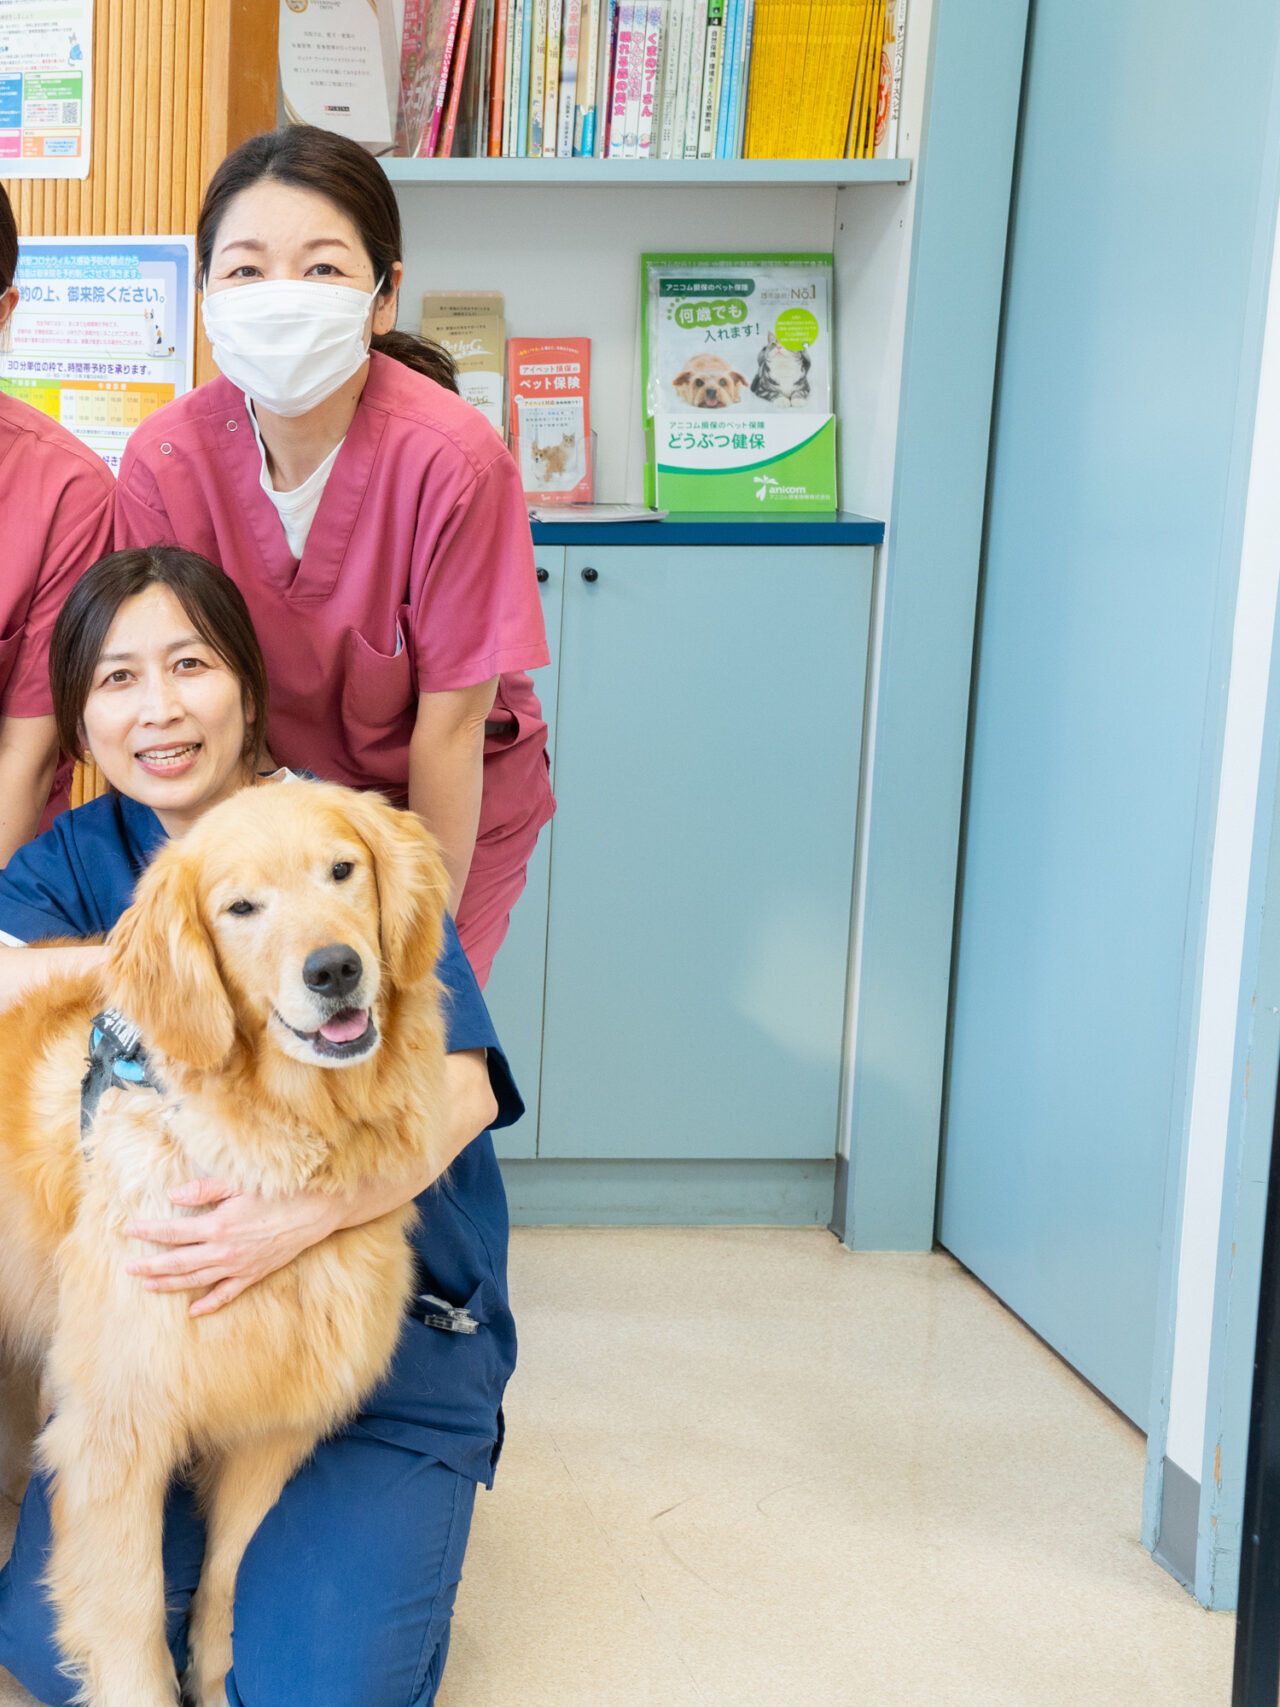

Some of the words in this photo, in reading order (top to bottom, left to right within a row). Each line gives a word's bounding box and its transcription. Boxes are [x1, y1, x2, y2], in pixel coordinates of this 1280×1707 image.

[679, 304, 742, 324] 何歳でも
[704, 322, 760, 343] 入れます!
[519, 376, 581, 390] ペット保険
[668, 432, 766, 449] どうぶつ健保
[769, 486, 807, 494] anicom
